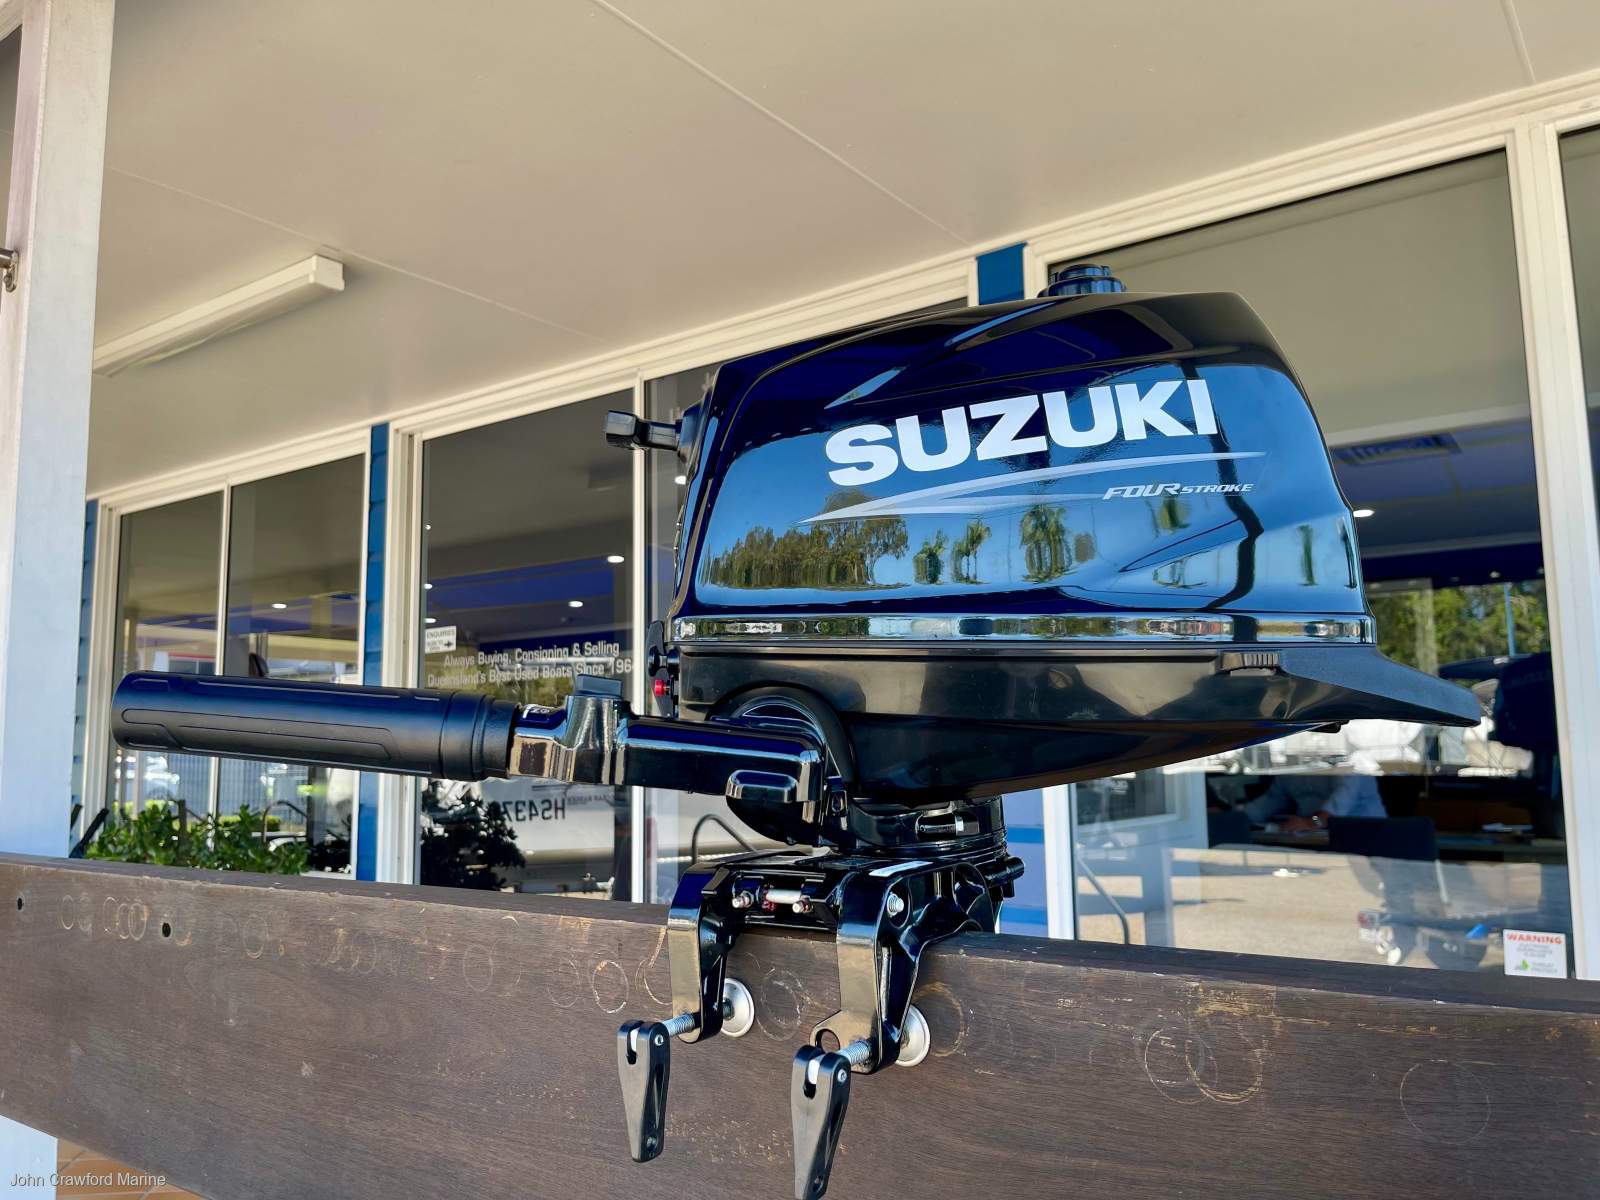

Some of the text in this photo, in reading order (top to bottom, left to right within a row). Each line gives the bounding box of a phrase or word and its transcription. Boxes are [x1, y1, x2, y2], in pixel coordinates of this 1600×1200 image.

[825, 379, 1218, 487] SUZUKI
[444, 640, 620, 669] Always Buying, Consigning & Selling
[427, 657, 635, 686] Queensland's Best Used Boats Since 196
[1507, 933, 1563, 945] WARNING
